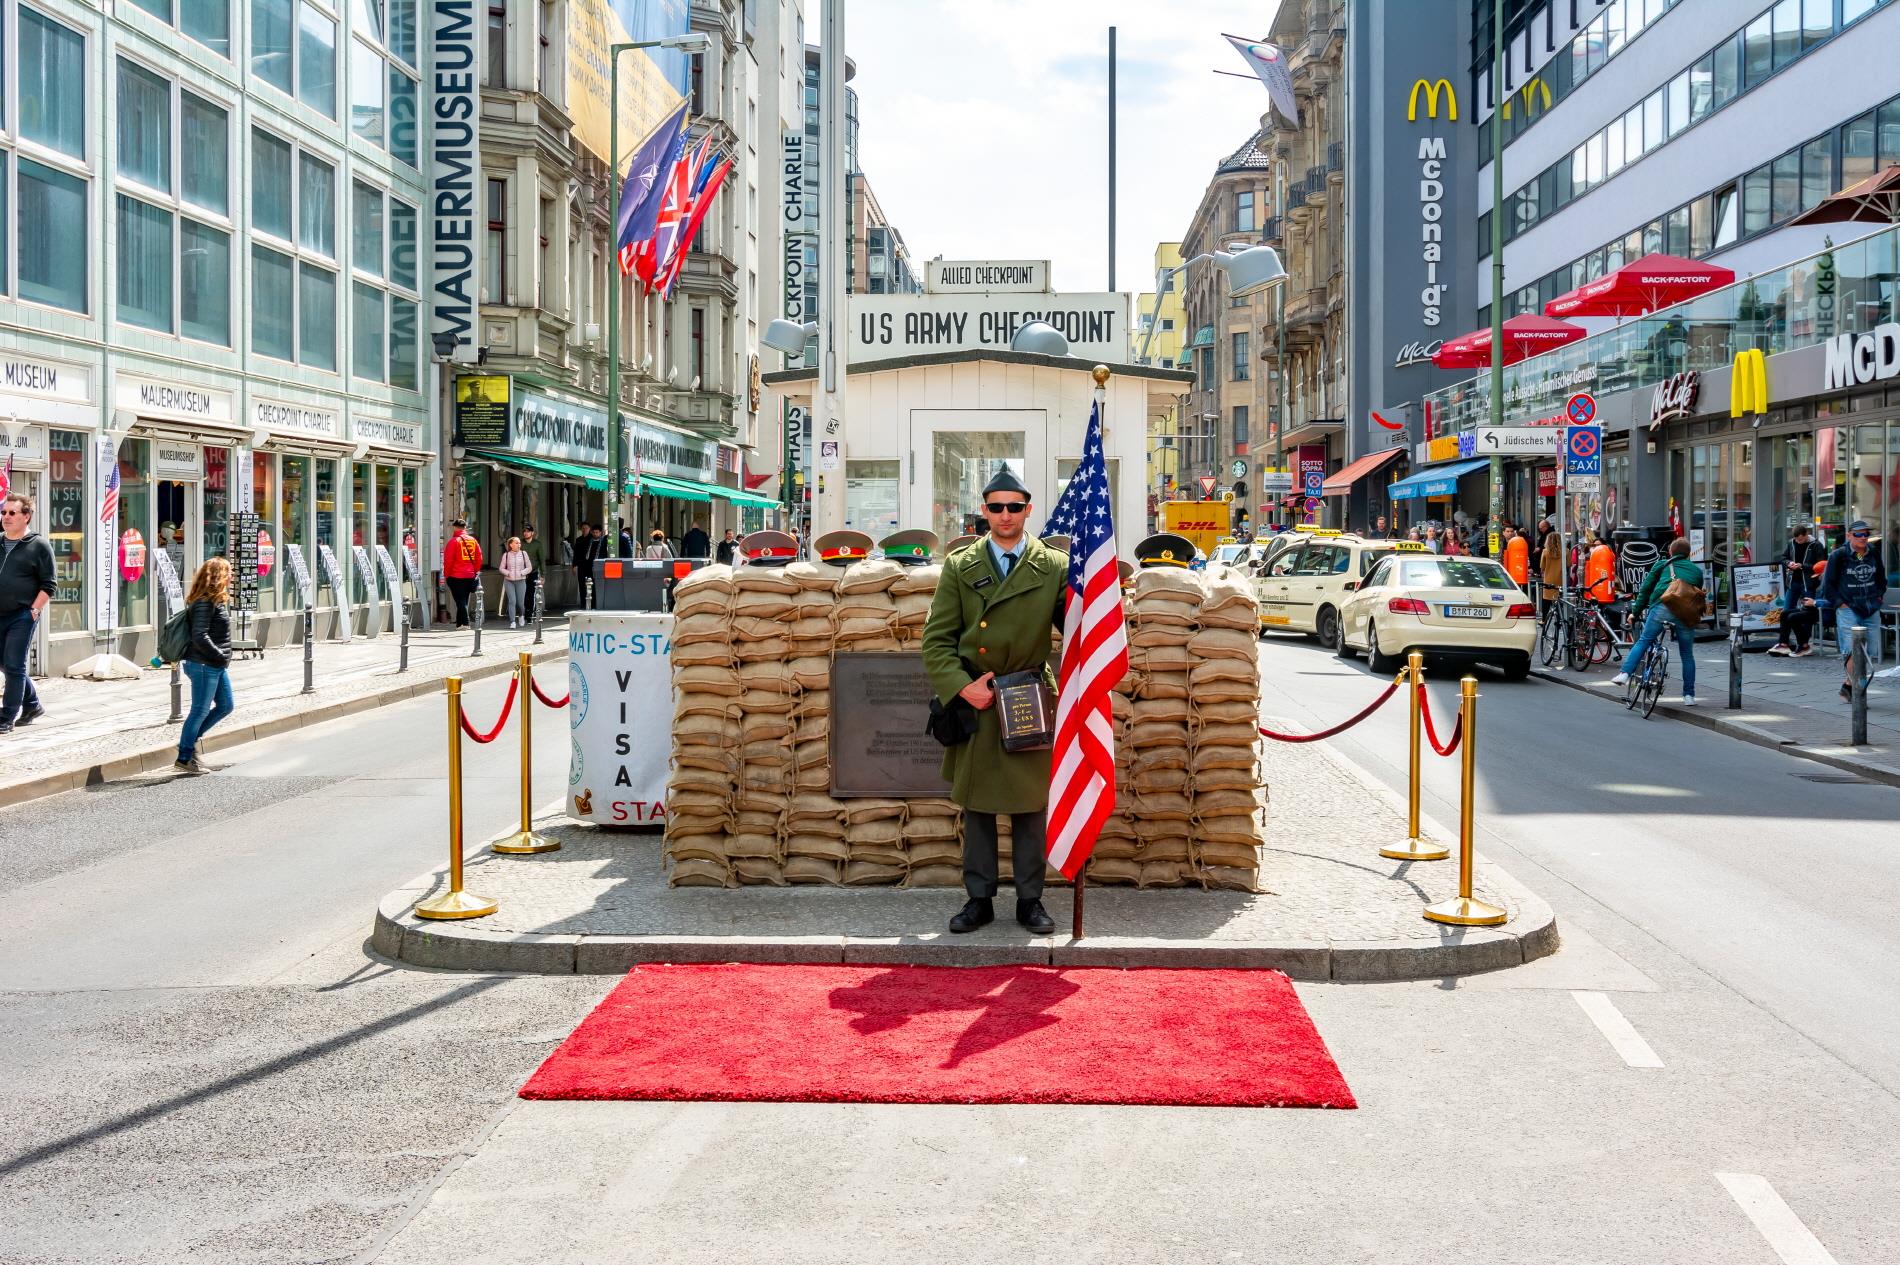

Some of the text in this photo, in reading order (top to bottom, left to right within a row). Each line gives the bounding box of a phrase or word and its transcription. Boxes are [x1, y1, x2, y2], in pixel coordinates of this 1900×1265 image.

[435, 1, 473, 345] MAUERMUSEUM
[785, 136, 802, 222] CHARLIE
[1418, 137, 1448, 326] McDonald's
[941, 266, 1034, 285] ALLIED CHECKPOINT
[861, 310, 1116, 345] US ARMY CHEPOINT
[1825, 322, 1900, 390] McD
[5, 361, 57, 392] MUSEUM
[141, 384, 210, 414] MAUERMUSEUM
[258, 403, 331, 432] CHECKPOINT CHARLIE
[357, 420, 414, 444] CHECKPOINT CHARLIE
[515, 407, 573, 445] CHECKPOINT
[574, 420, 604, 451] CHARLIE
[789, 407, 801, 461] HAUS
[1504, 435, 1567, 445] Jüdisches Mue
[160, 449, 196, 463] MUSEUMSSHOP
[1571, 460, 1598, 470] TAXI
[1177, 521, 1218, 530] DHL
[1473, 608, 1488, 617] 260
[614, 670, 632, 787] VISA
